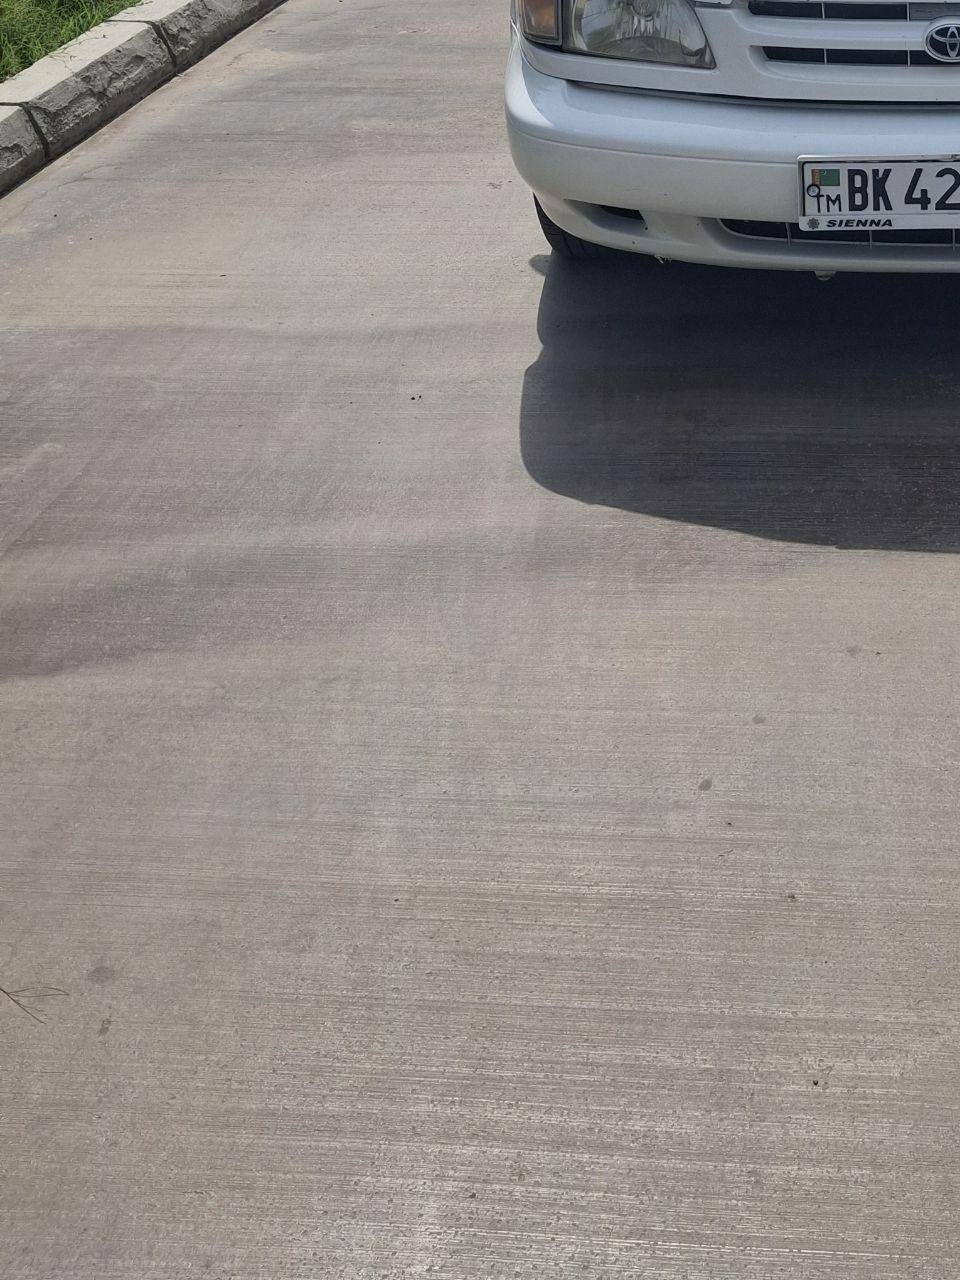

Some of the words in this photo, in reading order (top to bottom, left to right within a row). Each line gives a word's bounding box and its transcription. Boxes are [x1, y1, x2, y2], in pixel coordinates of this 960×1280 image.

[812, 193, 842, 213] TM
[847, 168, 893, 212] BK
[826, 219, 893, 228] SIENNA
